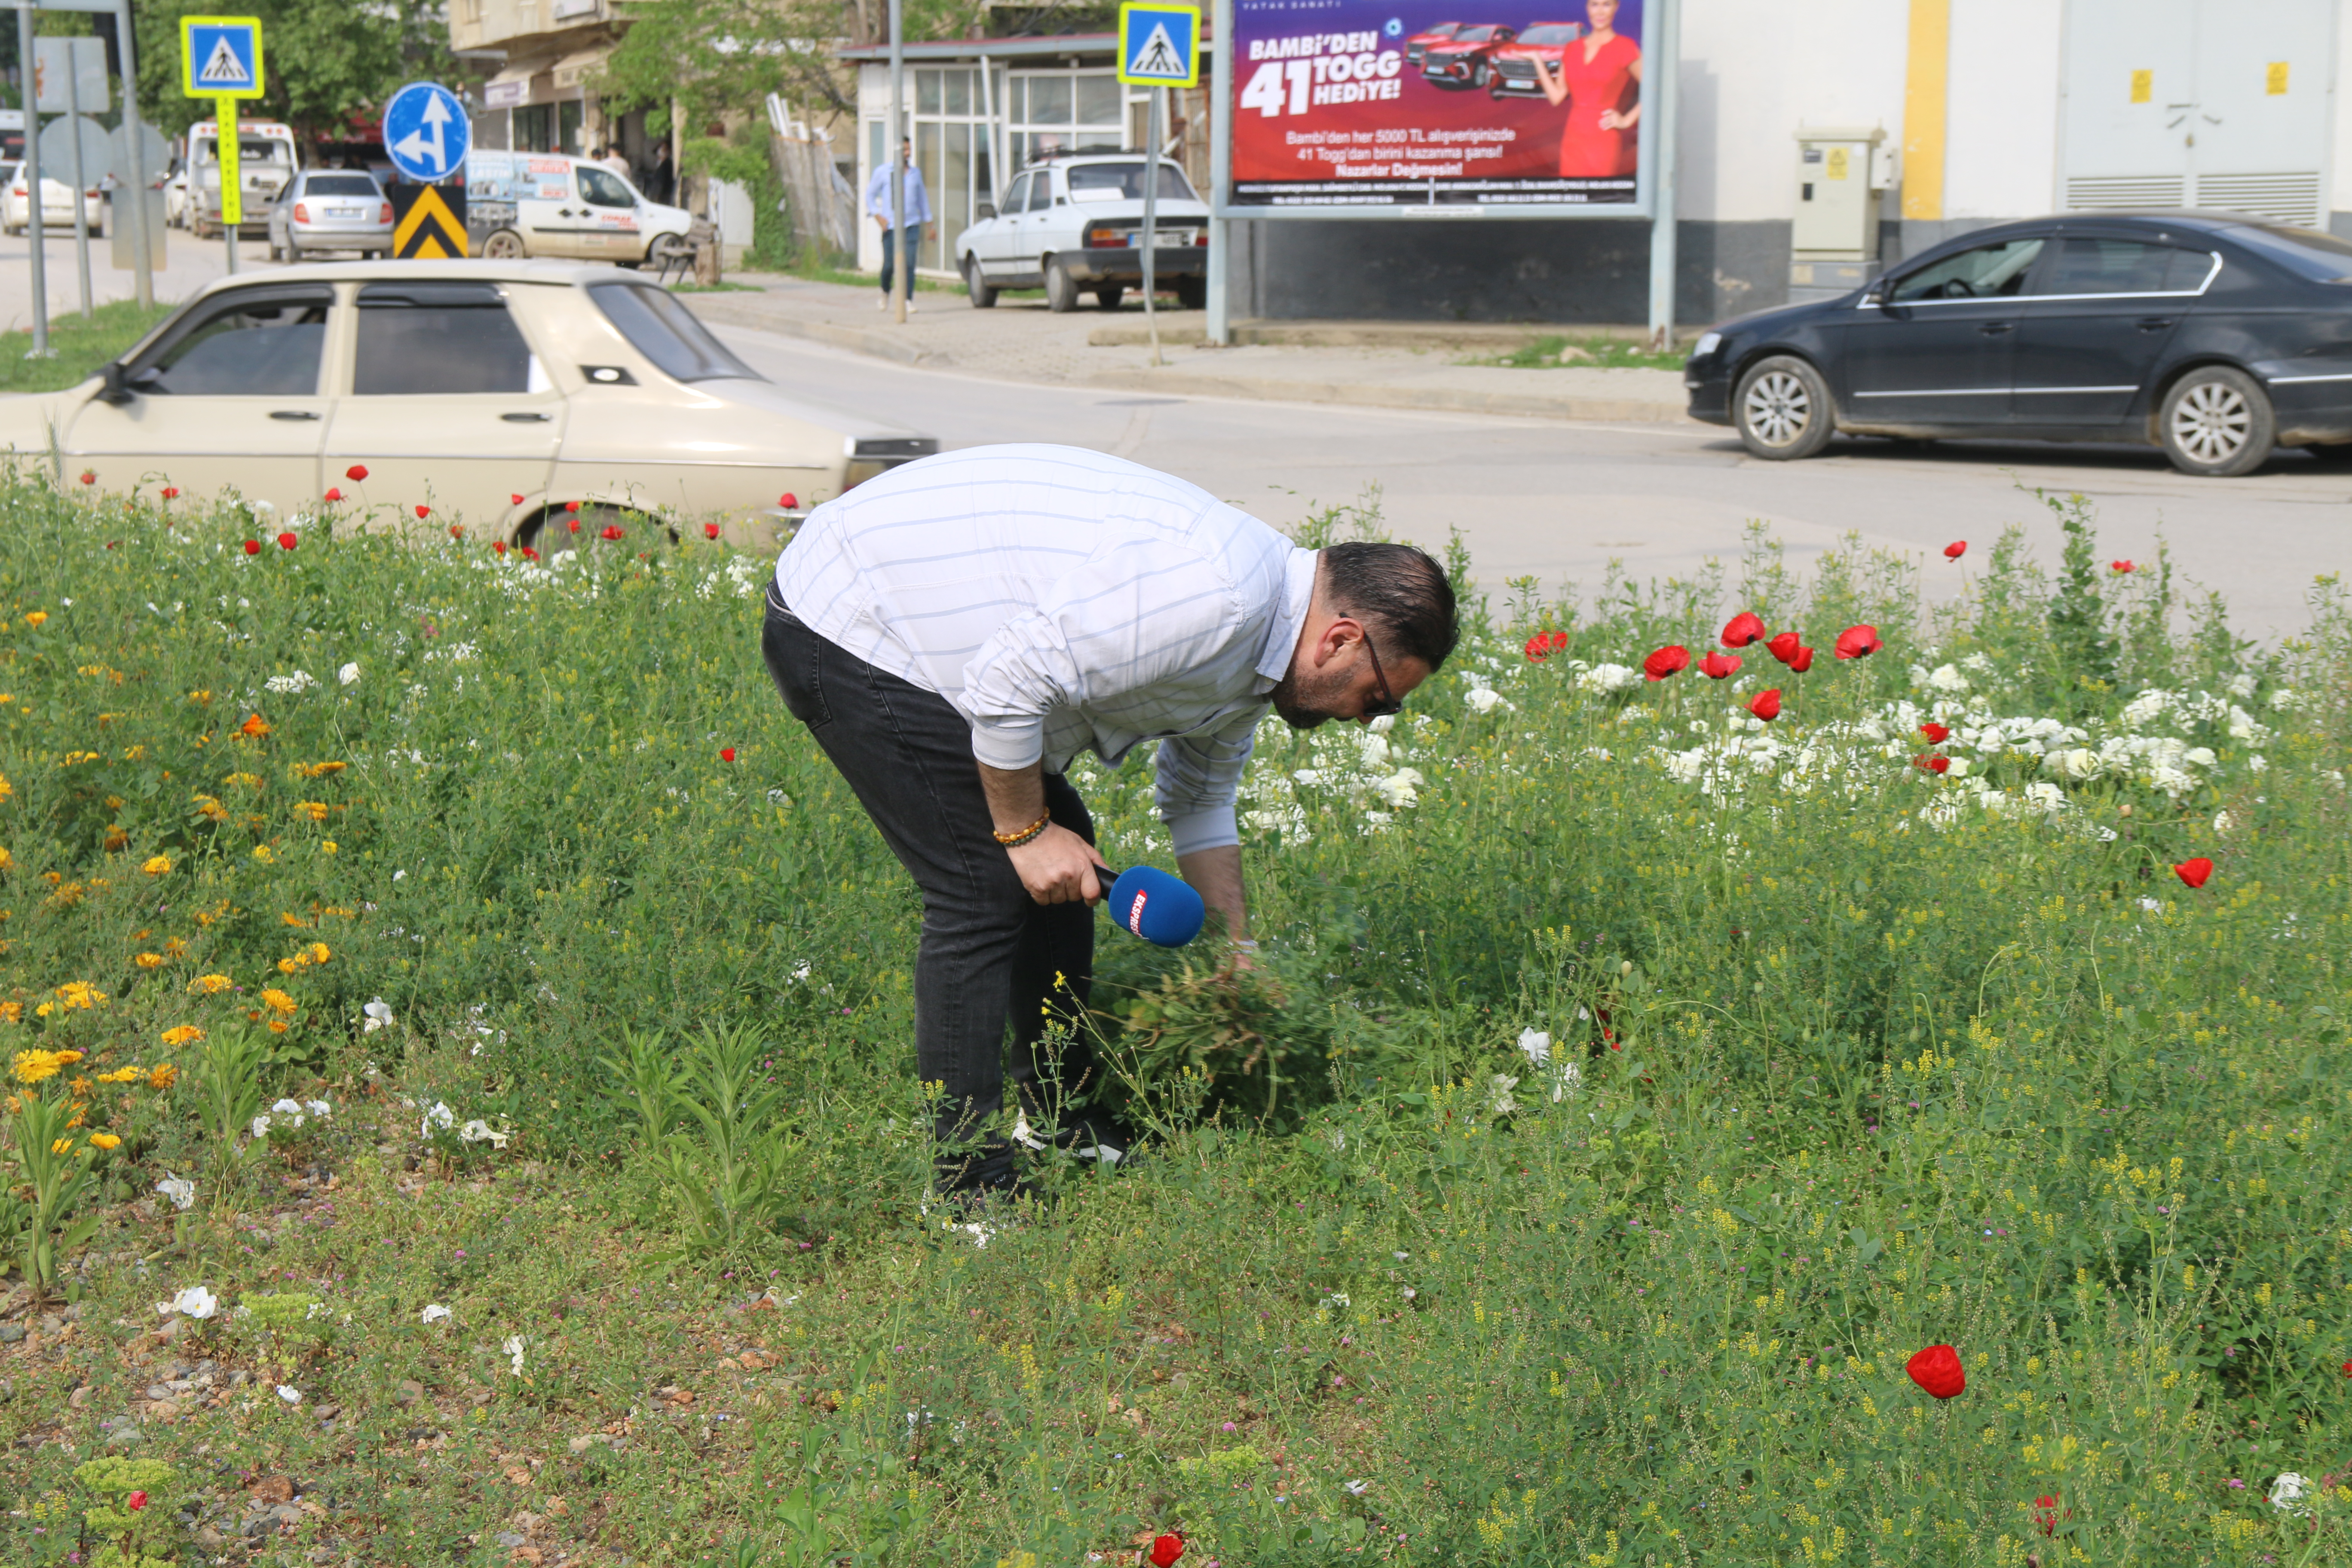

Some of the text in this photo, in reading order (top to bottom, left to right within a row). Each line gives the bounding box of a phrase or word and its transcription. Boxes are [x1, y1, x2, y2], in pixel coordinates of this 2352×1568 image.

[1240, 49, 1402, 118] 41 TOGG
[1286, 128, 1516, 145] Bambi'den her 5000 TL alışverişinizde
[1297, 145, 1503, 164] 41 Togg'dan birini kazanma şansı!
[1335, 162, 1464, 179] Nazarlar Değmesin!
[1130, 893, 1146, 934] EKSPRES
